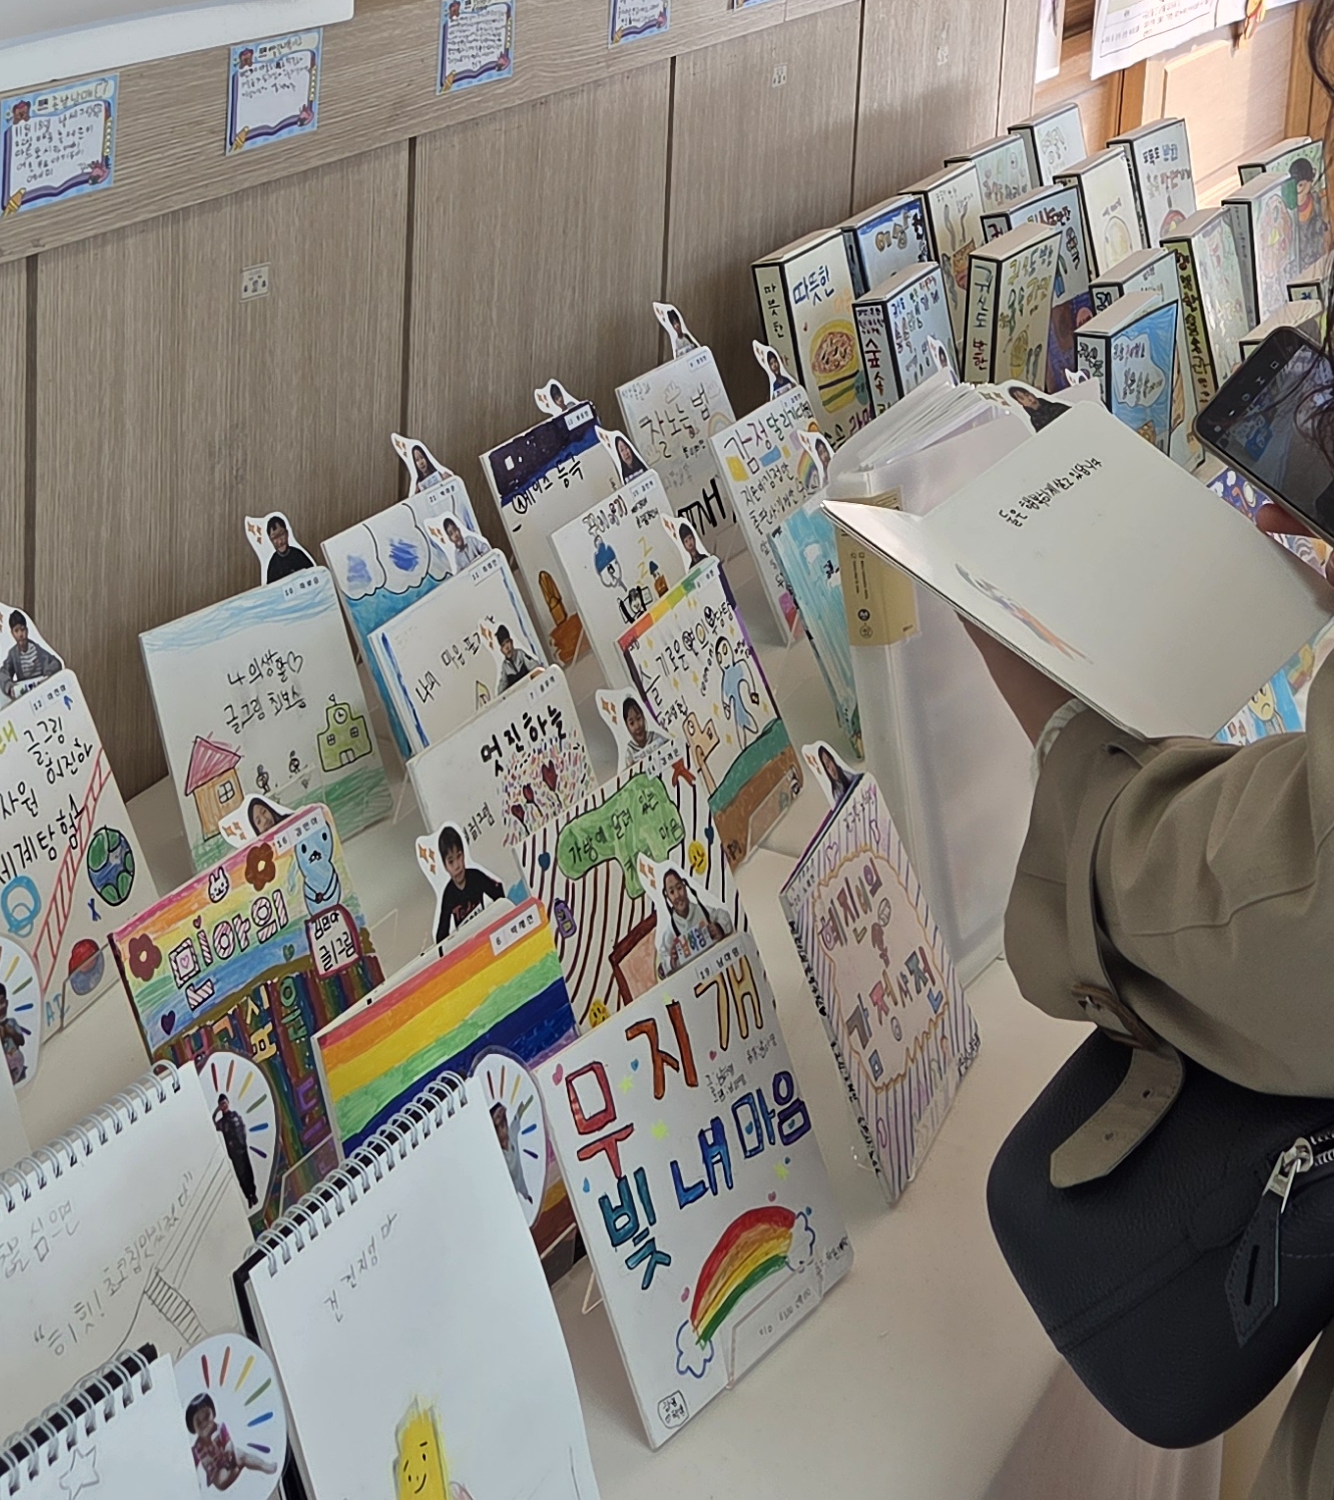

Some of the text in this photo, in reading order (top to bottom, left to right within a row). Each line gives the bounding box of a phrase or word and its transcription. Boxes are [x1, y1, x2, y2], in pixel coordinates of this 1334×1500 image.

[793, 265, 834, 306] 따뜻한
[568, 825, 608, 865] 가방에
[565, 955, 764, 1181] 무지개
[600, 1067, 813, 1290] 빛 내 마음
